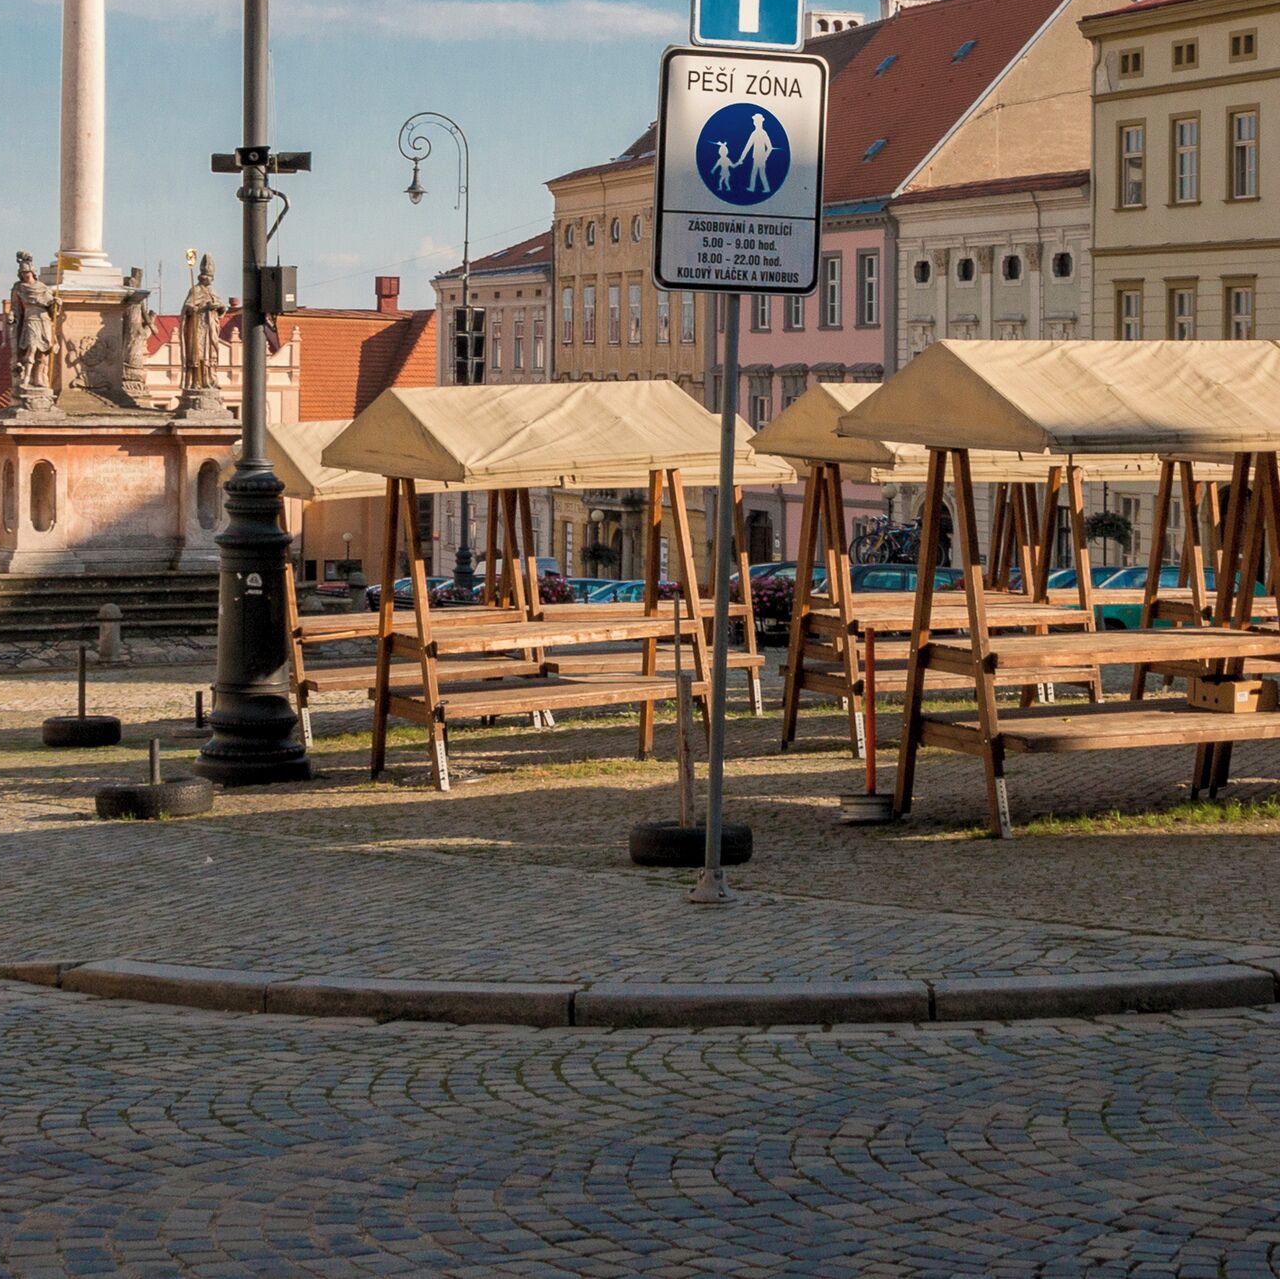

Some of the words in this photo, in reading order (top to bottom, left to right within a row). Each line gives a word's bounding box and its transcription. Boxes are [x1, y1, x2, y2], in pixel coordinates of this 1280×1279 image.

[687, 66, 736, 93] PĚŠÍ
[745, 70, 802, 98] ZÓNA
[688, 217, 746, 233] ZÁSOBOVÁNÍ
[748, 223, 755, 234] A
[758, 222, 793, 236] BYDLÍCÍ
[702, 237, 724, 248] 5.00
[735, 239, 756, 249] 9.00
[758, 240, 777, 251] hod.
[697, 252, 723, 264] 18.00
[734, 254, 760, 266] 22.00
[763, 255, 782, 267] hod.
[677, 266, 713, 279] KOLOVÝ
[714, 266, 750, 281] VLÁČEK
[751, 271, 758, 281] A
[760, 271, 799, 283] VINOBUS
